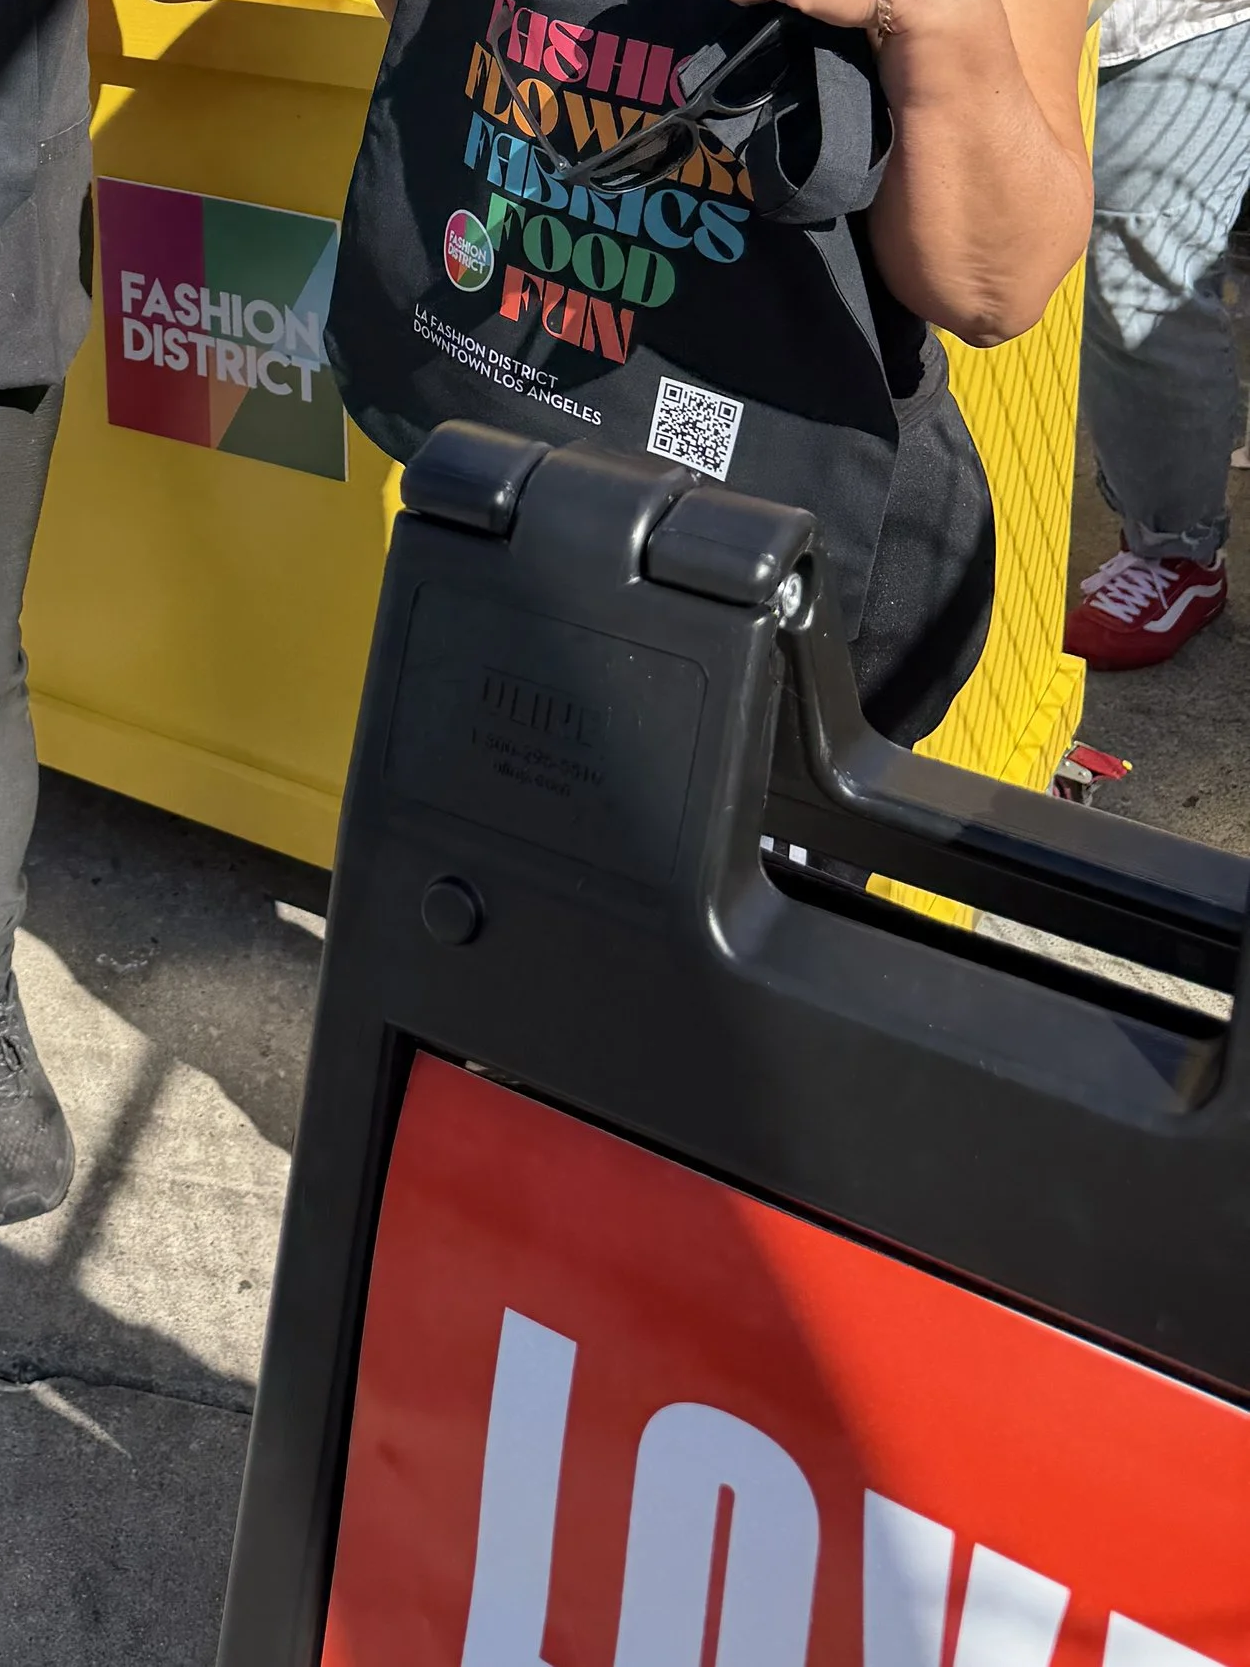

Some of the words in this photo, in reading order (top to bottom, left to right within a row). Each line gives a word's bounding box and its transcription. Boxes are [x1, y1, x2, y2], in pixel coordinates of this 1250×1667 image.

[447, 242, 486, 275] DISTRICT
[449, 229, 487, 262] FASHION
[486, 192, 676, 308] FOOD
[120, 269, 321, 360] FASHION
[414, 303, 428, 324] LA
[430, 315, 486, 359] FASHION
[488, 348, 559, 390] DISTRICT
[500, 264, 635, 365] FUN
[122, 316, 321, 404] DISTRICT
[413, 319, 491, 379] DOWNTOWN
[493, 368, 524, 394] LOS
[527, 386, 602, 426] ANGELES
